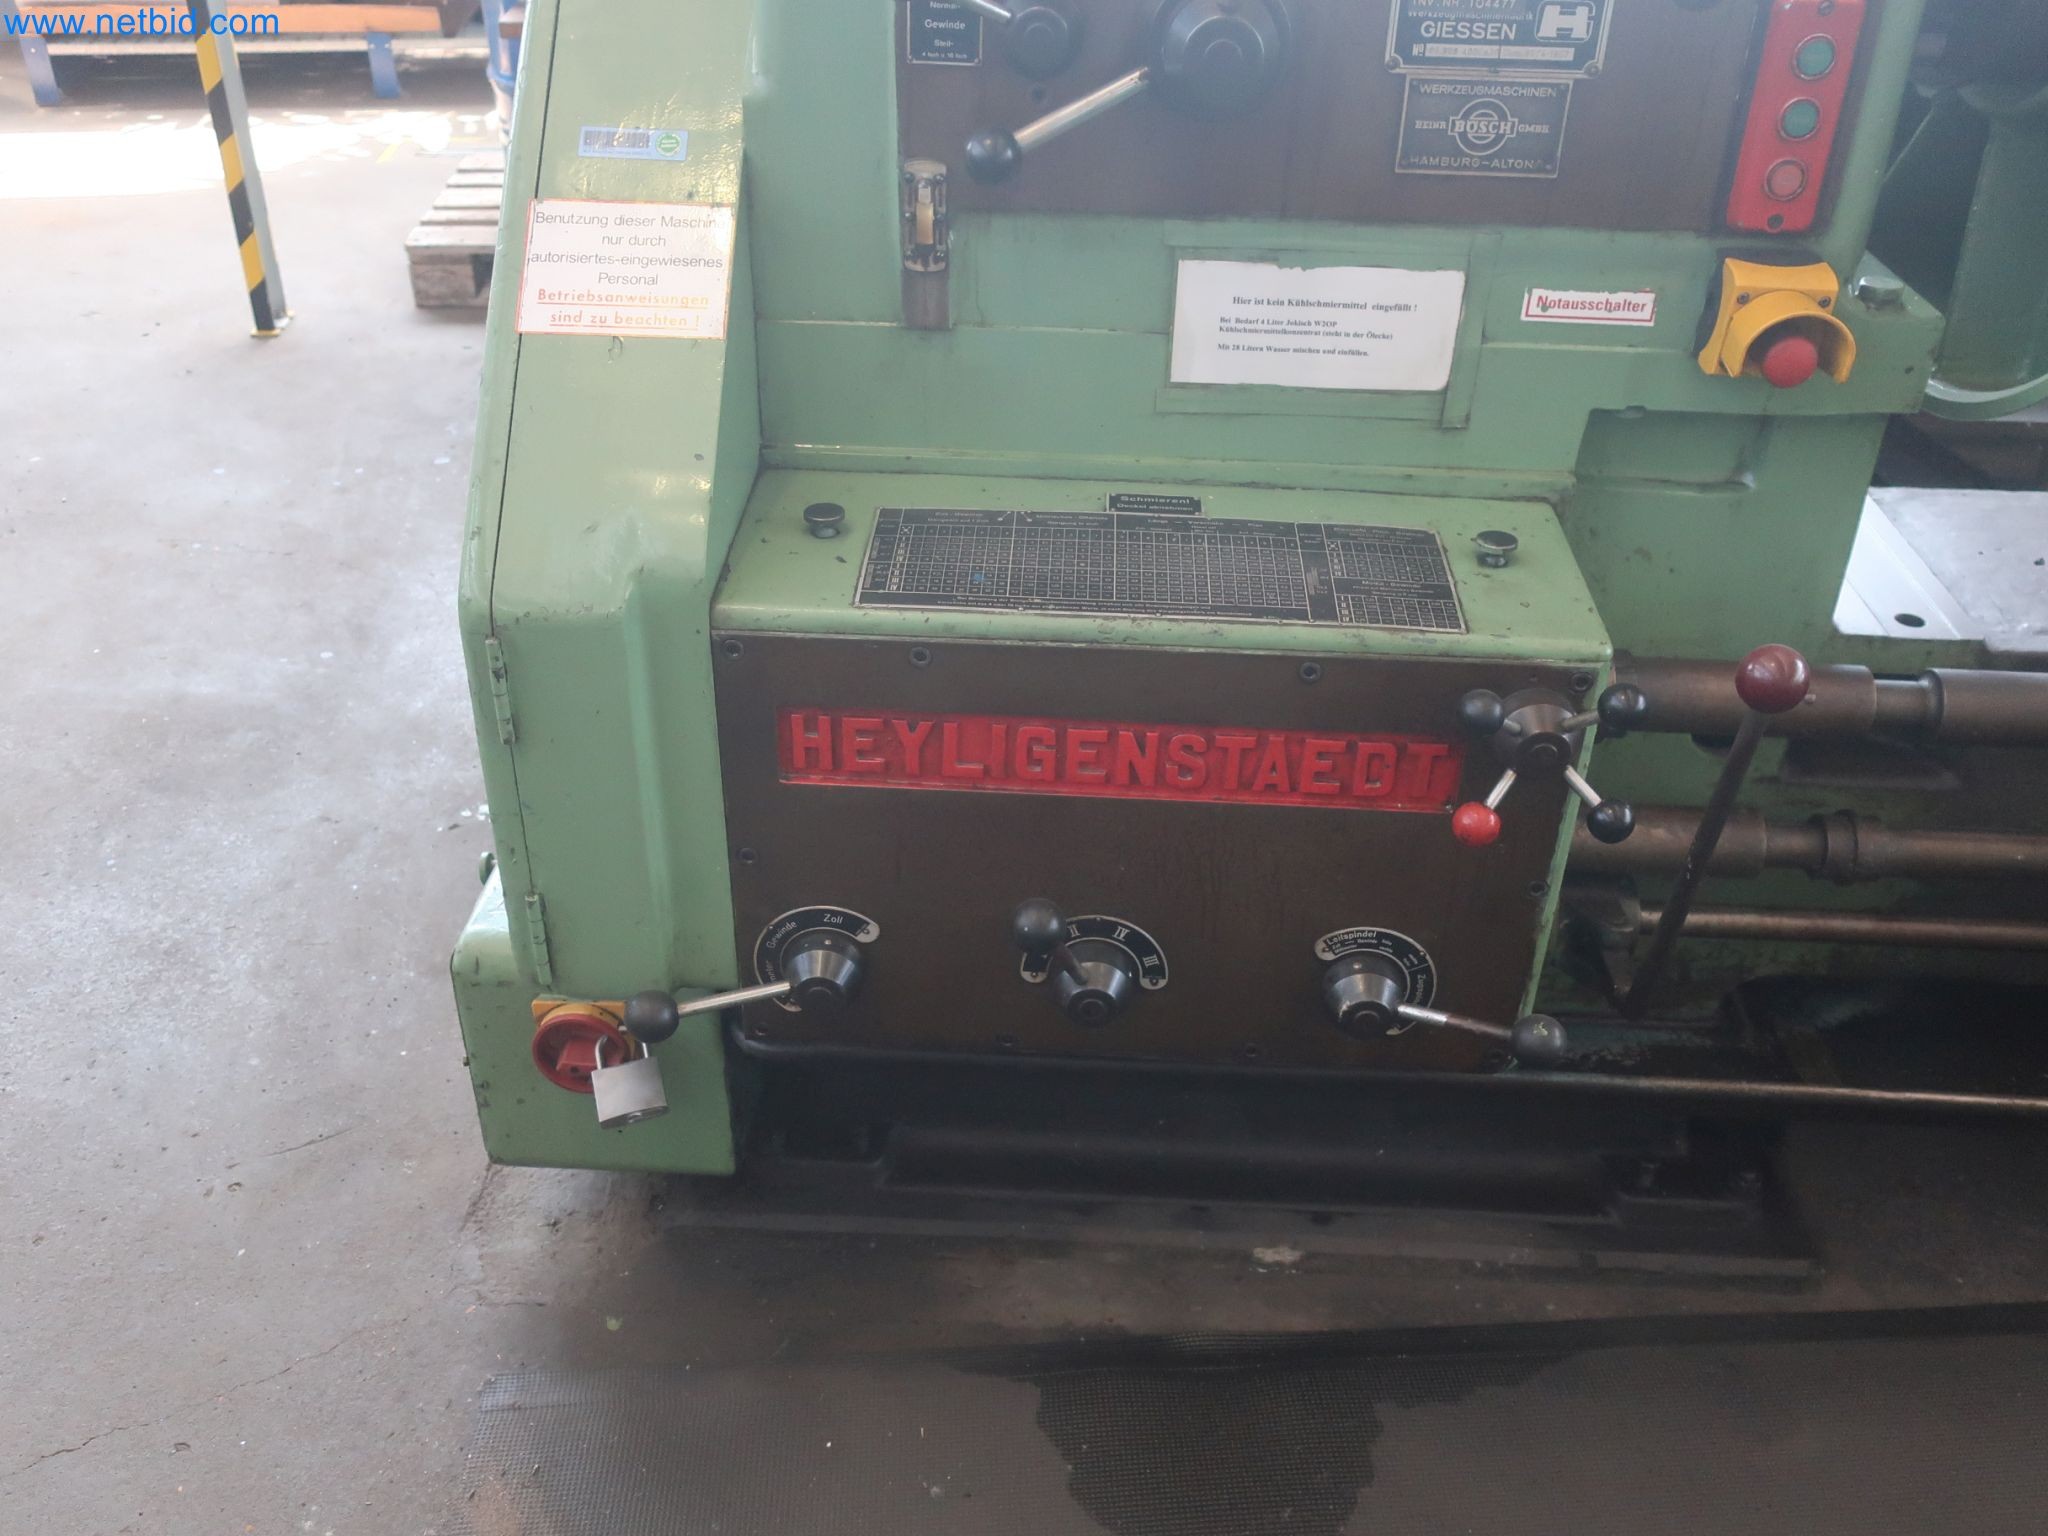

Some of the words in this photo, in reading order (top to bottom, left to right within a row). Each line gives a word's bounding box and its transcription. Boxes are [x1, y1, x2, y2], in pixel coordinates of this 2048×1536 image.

[924, 19, 966, 30] Gewinde
[1420, 20, 1516, 40] GIESSEN
[1420, 84, 1556, 97] WERKZEUGMASCHINEN
[535, 212, 608, 228] Benutzung
[614, 214, 656, 227] dieser
[602, 234, 624, 245] nur
[629, 233, 666, 247] durch
[531, 251, 723, 268] autorisiertes-eingewiesenes
[598, 272, 659, 286] Personal
[538, 288, 709, 305] Betriebsanweisungen
[1233, 296, 1252, 305] Hier
[1254, 297, 1264, 306] ist
[1267, 298, 1285, 306] kein
[1287, 298, 1367, 310] Kühlschmiermittel
[1372, 303, 1412, 313] eingefüllt
[1537, 295, 1648, 313] Notausschalter
[551, 310, 582, 323] sind
[590, 314, 607, 324] zu
[614, 312, 687, 327] beachten
[791, 713, 1450, 797] HEYLIGENSTAEDT
[823, 913, 844, 924] Zoll
[766, 920, 798, 949] Gewinde
[1112, 926, 1131, 941] IV
[1327, 930, 1377, 946] Leitspindel
[1142, 953, 1160, 968] III
